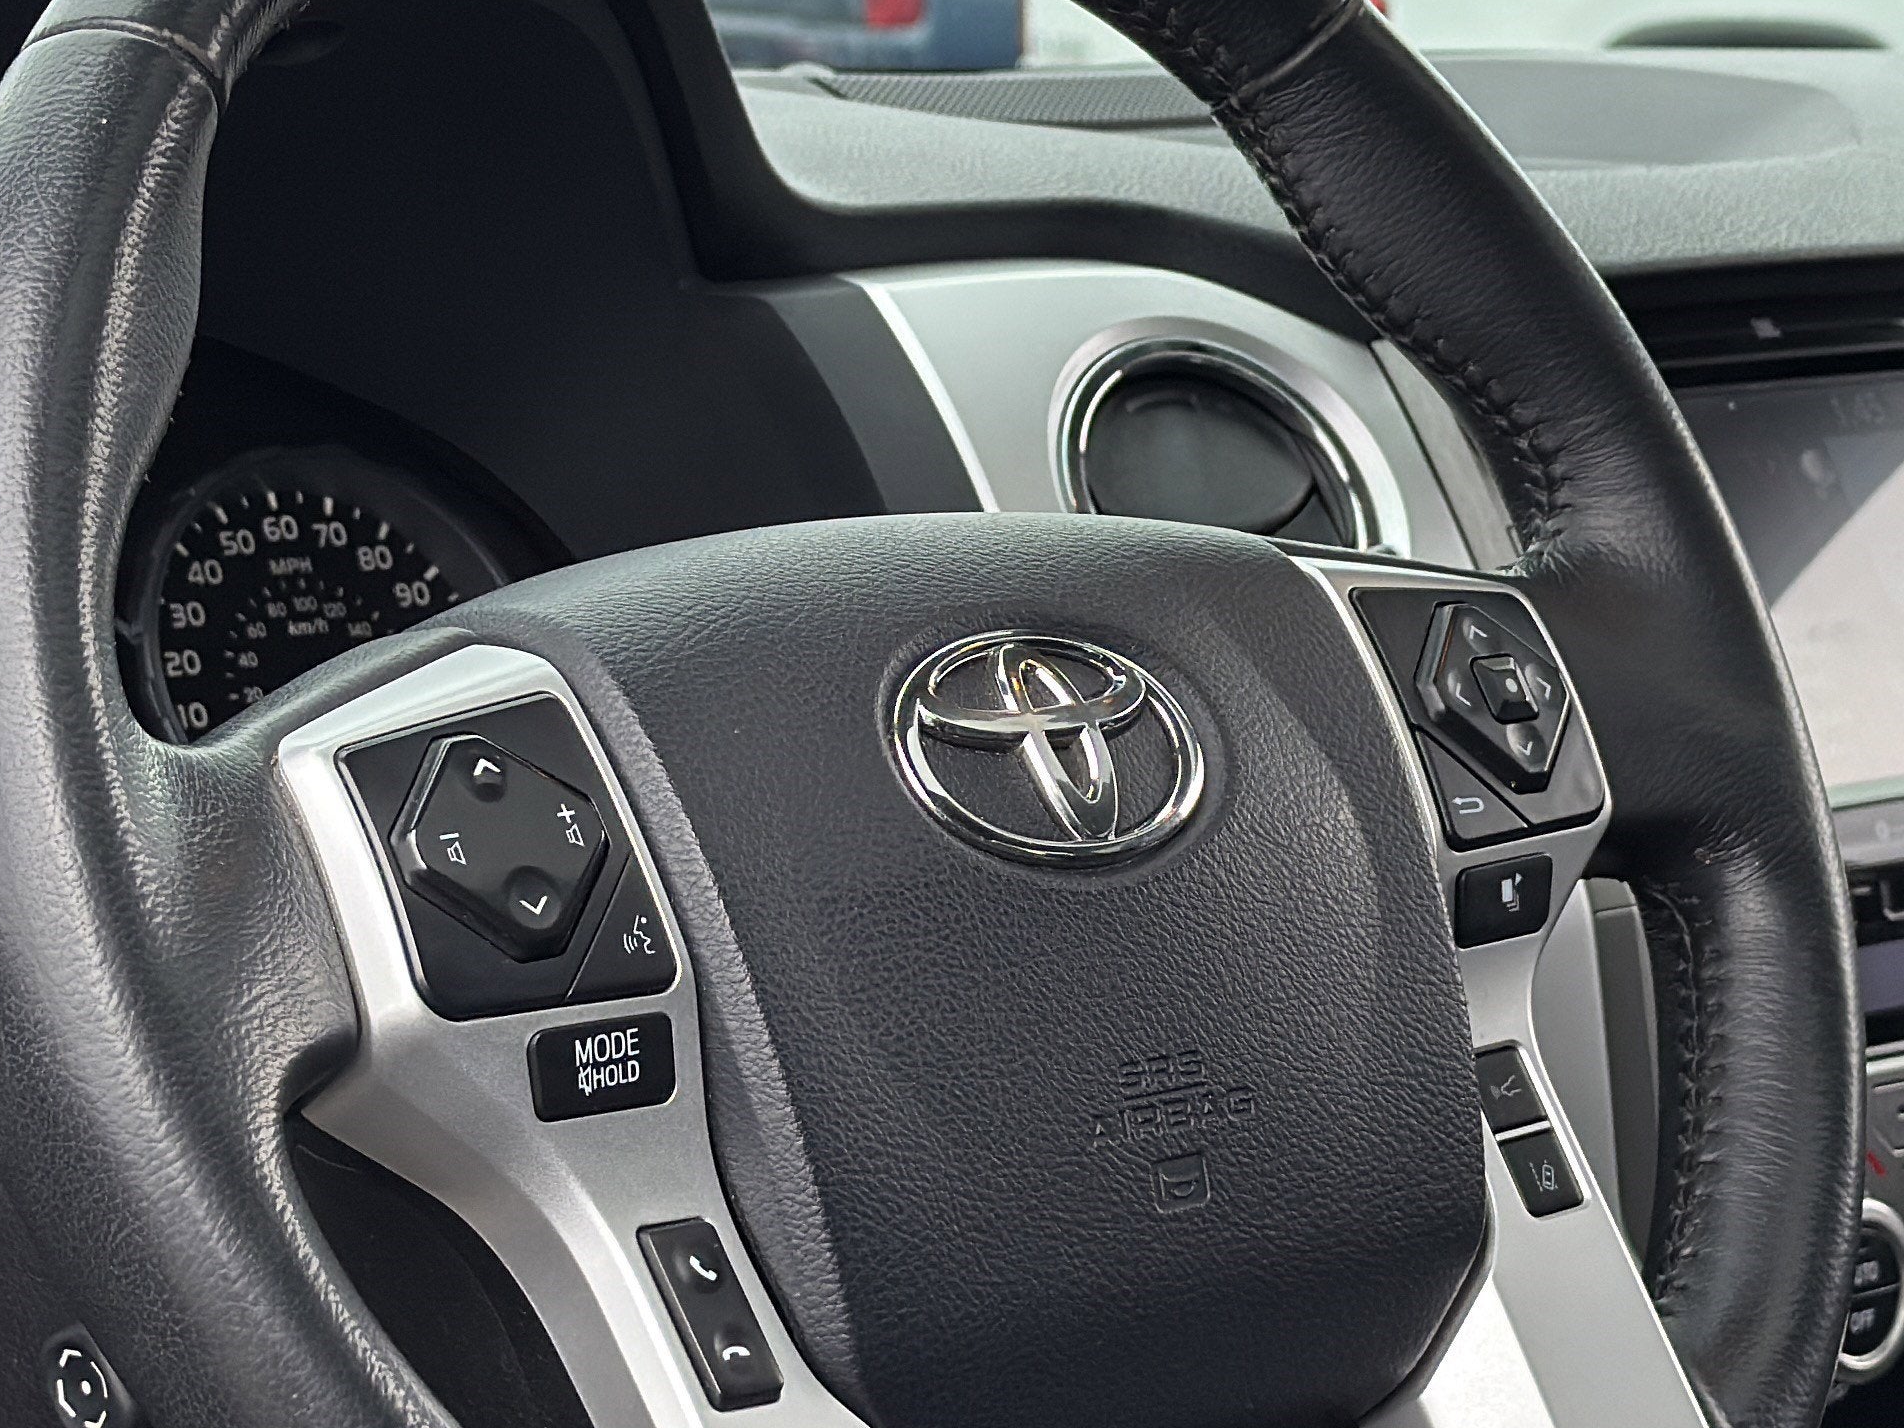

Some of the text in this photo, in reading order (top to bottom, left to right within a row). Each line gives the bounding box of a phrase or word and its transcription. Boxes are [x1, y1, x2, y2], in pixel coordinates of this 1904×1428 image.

[262, 515, 298, 543] 60
[311, 521, 347, 549] 70
[219, 530, 256, 558] 50
[356, 544, 393, 572] 80
[187, 559, 223, 586] 40
[269, 556, 313, 575] MPH
[393, 580, 431, 608] 90
[169, 601, 206, 628] 30
[164, 649, 202, 677] 20
[177, 701, 209, 730] 10
[575, 1027, 640, 1068] MODE
[592, 1060, 641, 1091] HOLD
